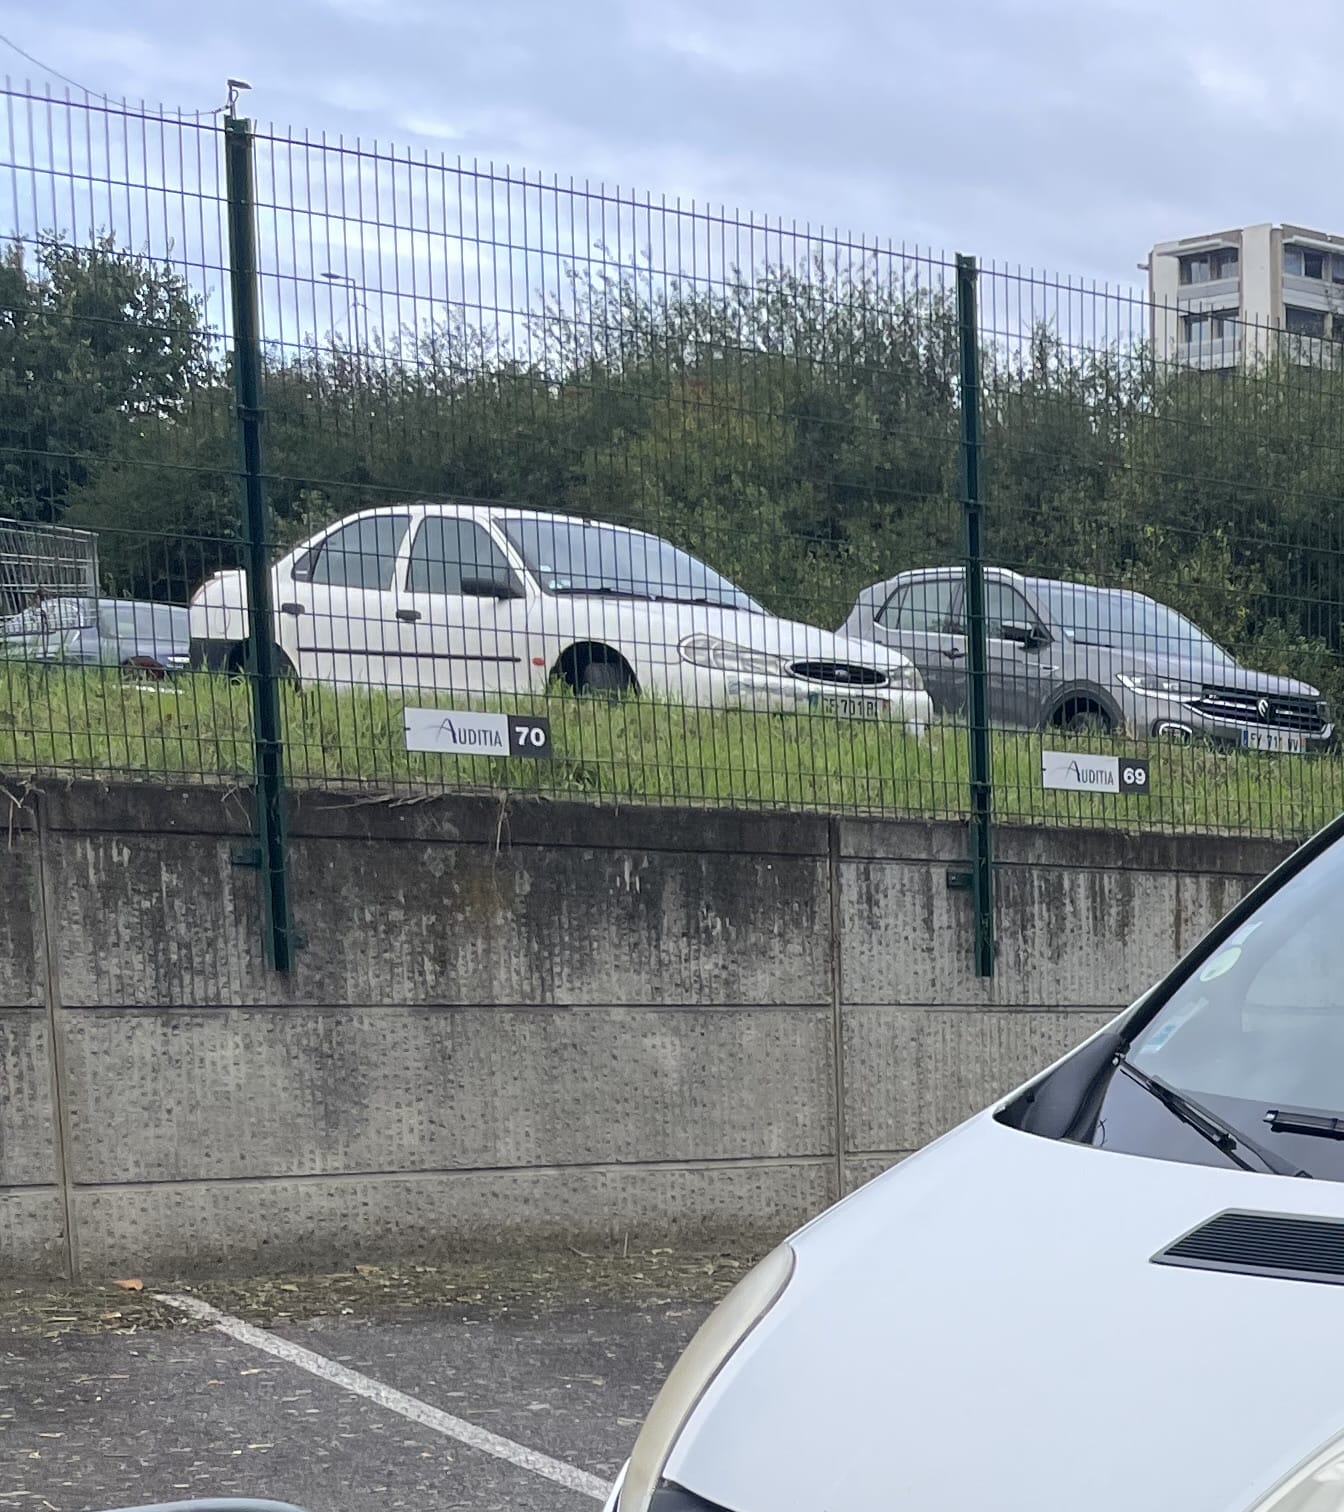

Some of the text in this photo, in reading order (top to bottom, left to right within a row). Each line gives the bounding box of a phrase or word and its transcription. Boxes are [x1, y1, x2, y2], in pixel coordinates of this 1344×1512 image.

[427, 718, 546, 747] AUDITIA 70
[1054, 760, 1146, 786] AUDITIA 69
